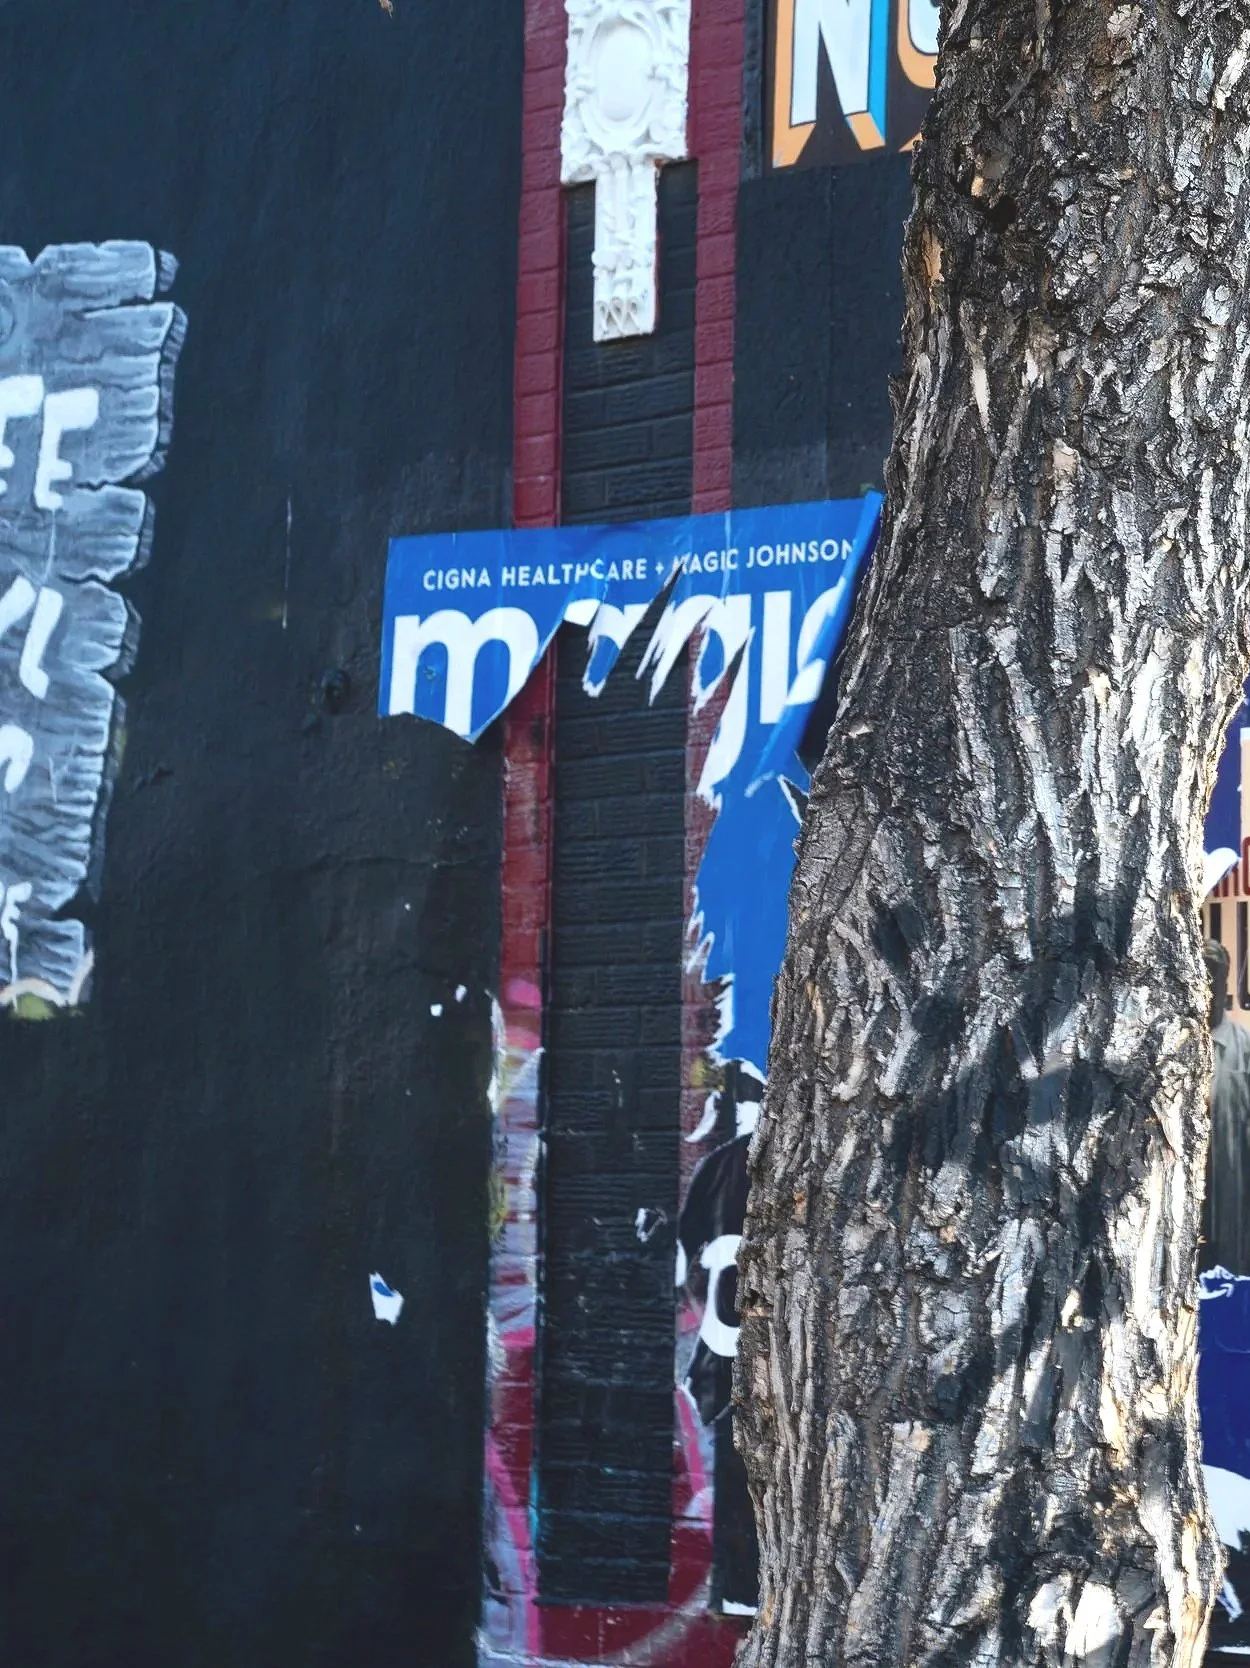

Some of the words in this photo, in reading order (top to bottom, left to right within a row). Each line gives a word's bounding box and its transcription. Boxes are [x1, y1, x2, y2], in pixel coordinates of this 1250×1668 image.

[422, 567, 491, 591] CIGNA
[501, 557, 648, 588] HEALTHCARE
[746, 538, 854, 569] JOHNSON
